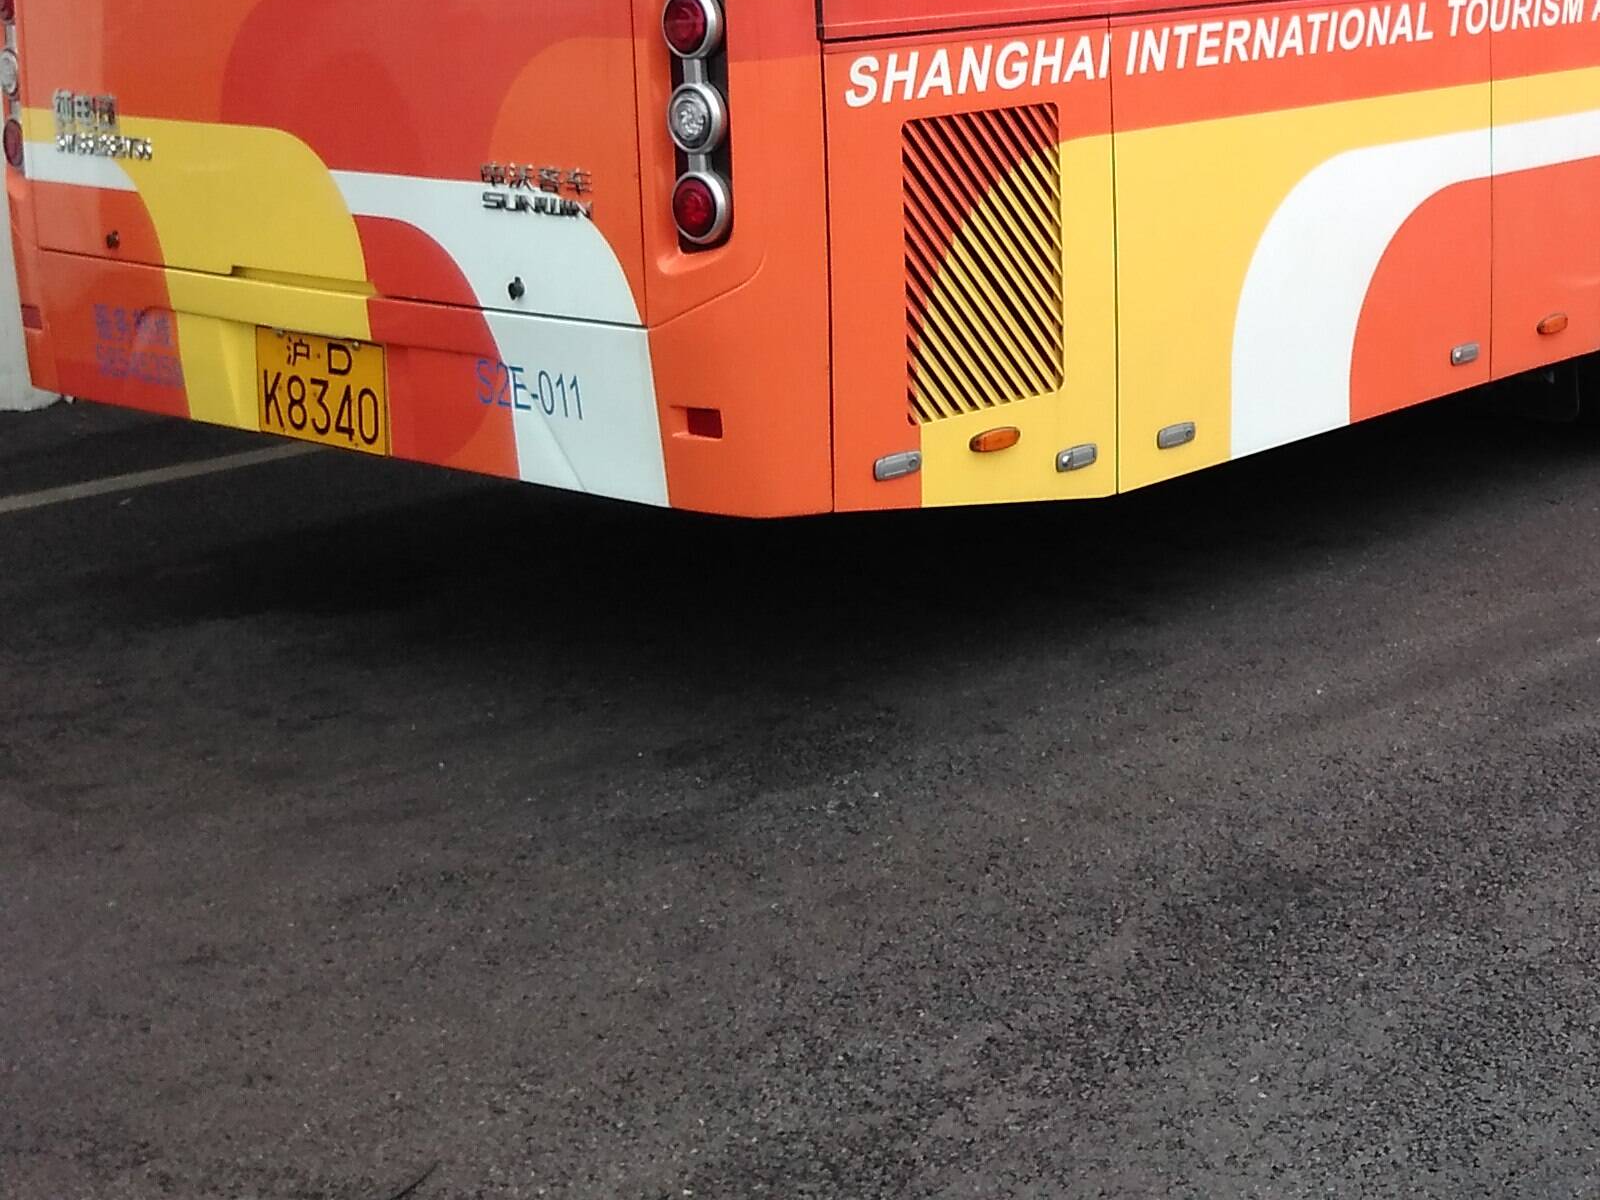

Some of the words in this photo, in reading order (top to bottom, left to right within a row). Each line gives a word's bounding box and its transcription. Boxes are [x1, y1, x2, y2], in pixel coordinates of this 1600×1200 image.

[845, 33, 1112, 108] SHANGHAI
[1125, 2, 1434, 76] INTERNATIONAL
[480, 161, 592, 195] 申沃客车
[482, 191, 593, 220] SUNWIN
[264, 369, 379, 445] K8340
[477, 358, 583, 421] S2E-011
